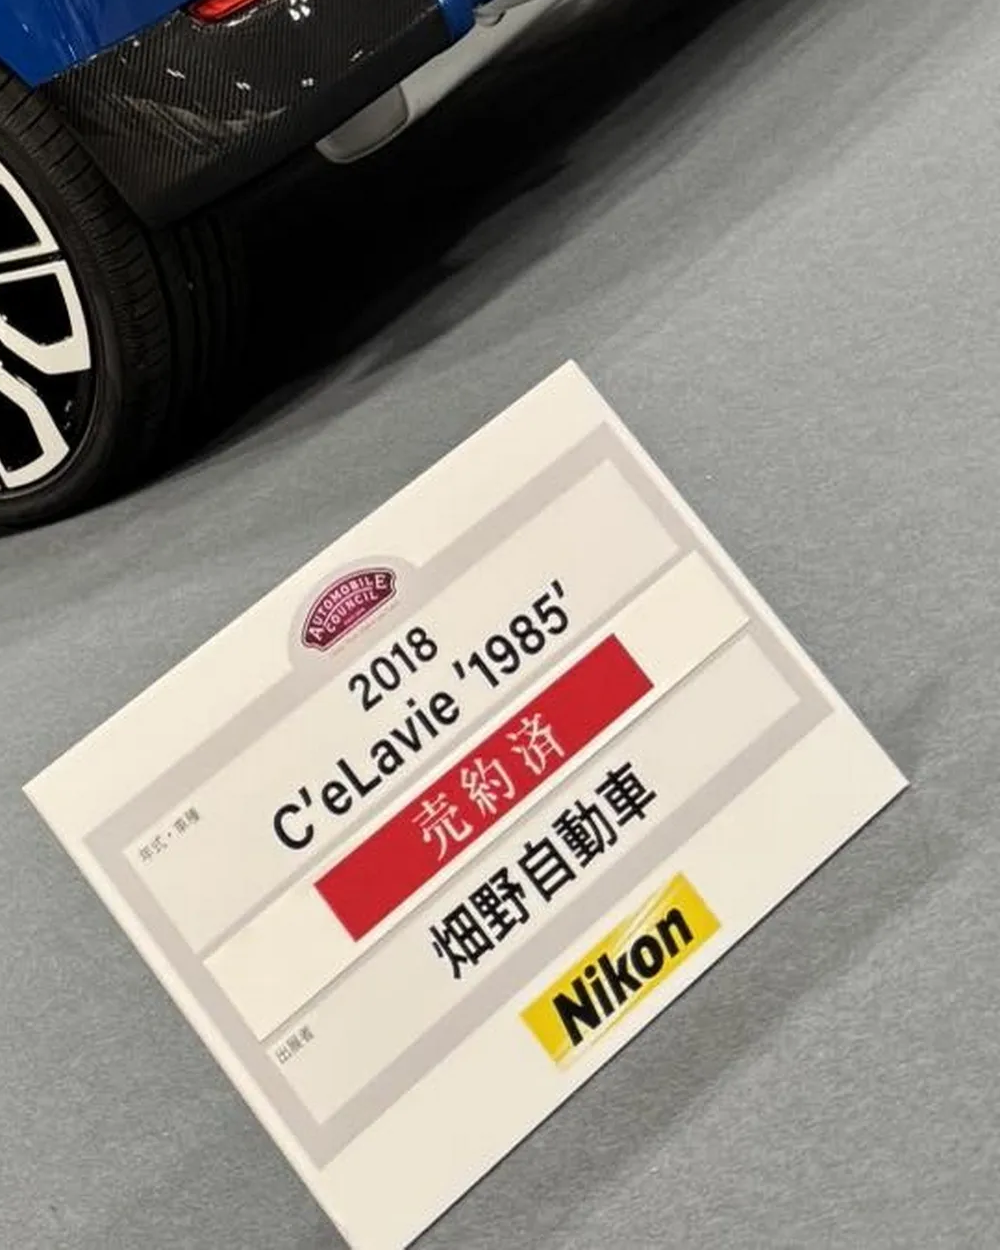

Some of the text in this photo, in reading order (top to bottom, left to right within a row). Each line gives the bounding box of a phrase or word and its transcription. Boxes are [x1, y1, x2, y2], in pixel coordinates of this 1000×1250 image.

[309, 574, 387, 640] AUTOMOBILE
[326, 591, 379, 633] COUNCIL
[348, 626, 438, 711] 2018
[273, 691, 460, 850] C'eLavie
[452, 580, 569, 688] '1985'
[412, 713, 565, 861] 売約済
[429, 762, 657, 979] 畑野自動車
[553, 908, 693, 1046] Nikon
